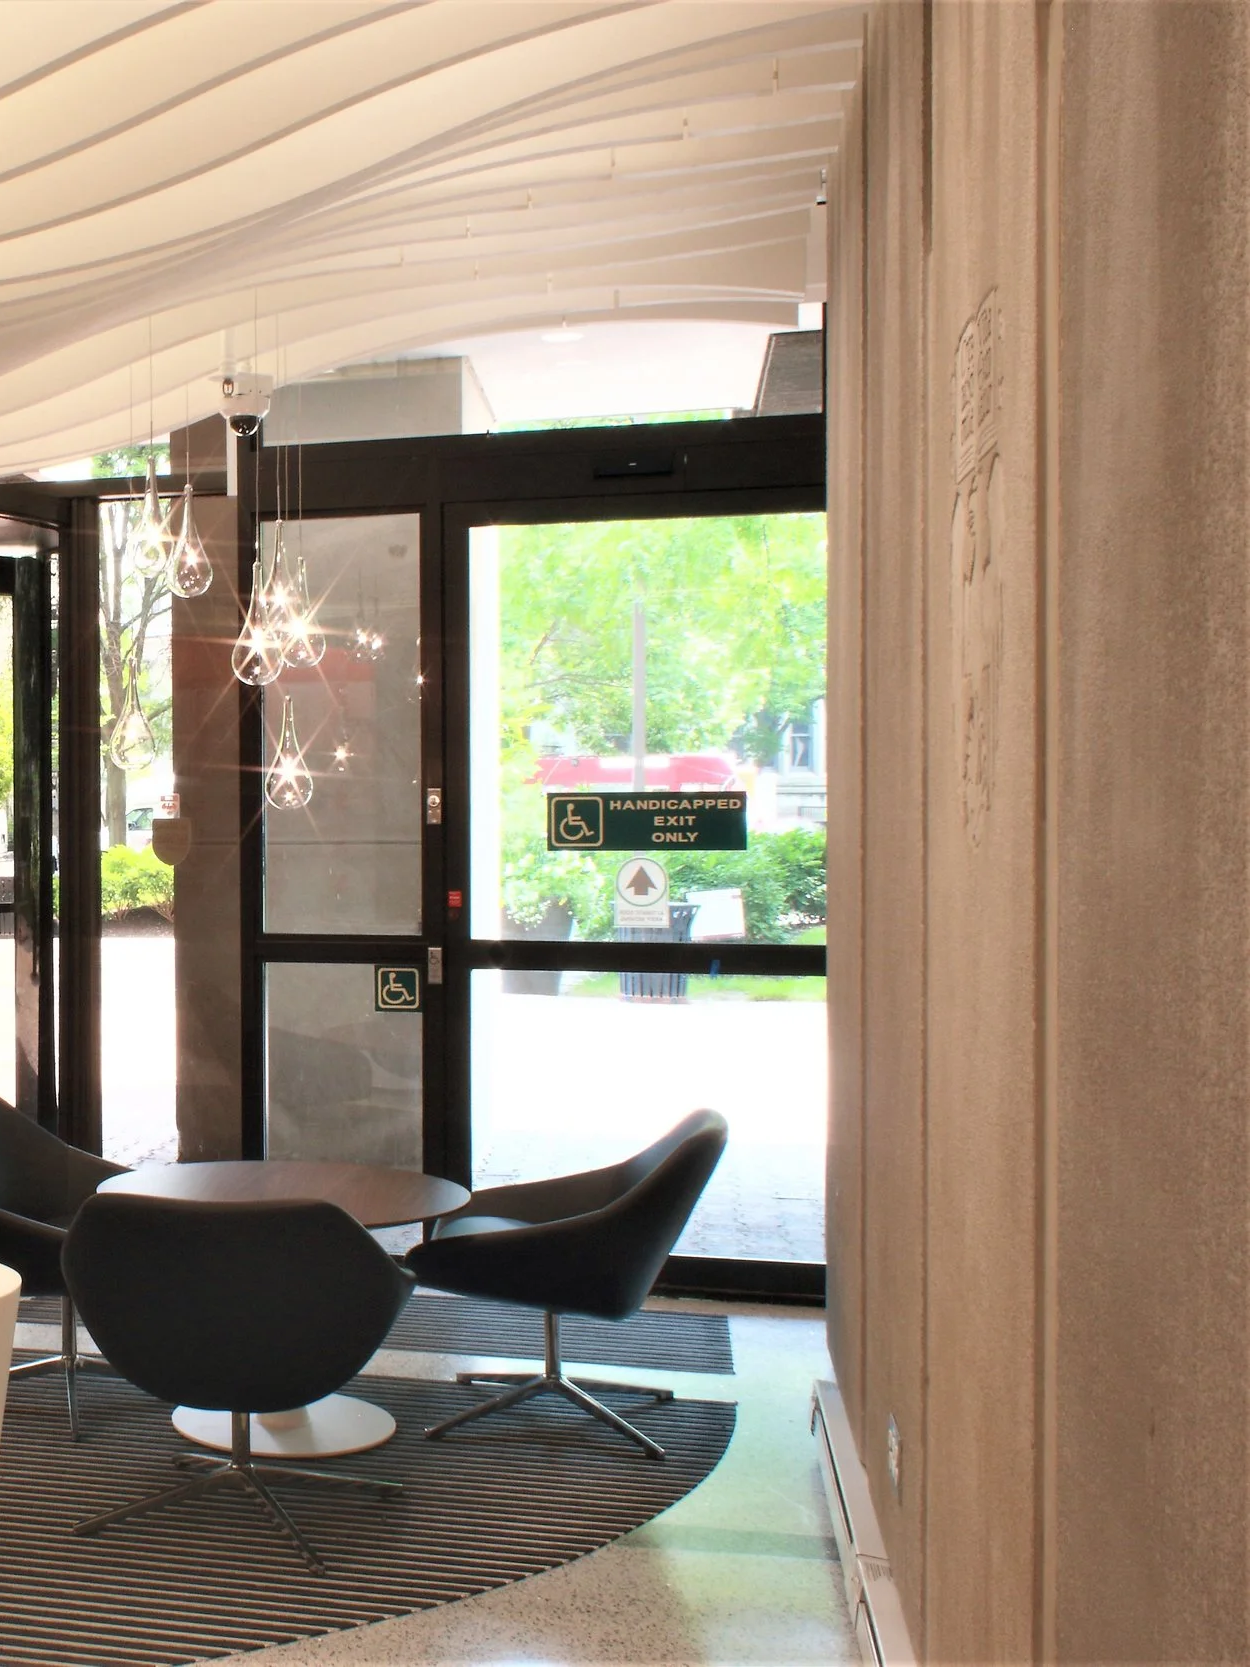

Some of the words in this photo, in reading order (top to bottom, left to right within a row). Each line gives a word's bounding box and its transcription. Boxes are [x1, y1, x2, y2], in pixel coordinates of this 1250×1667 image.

[610, 799, 742, 810] HANDICAPPED
[653, 815, 696, 826] EXIT
[651, 832, 699, 843] ONLY
